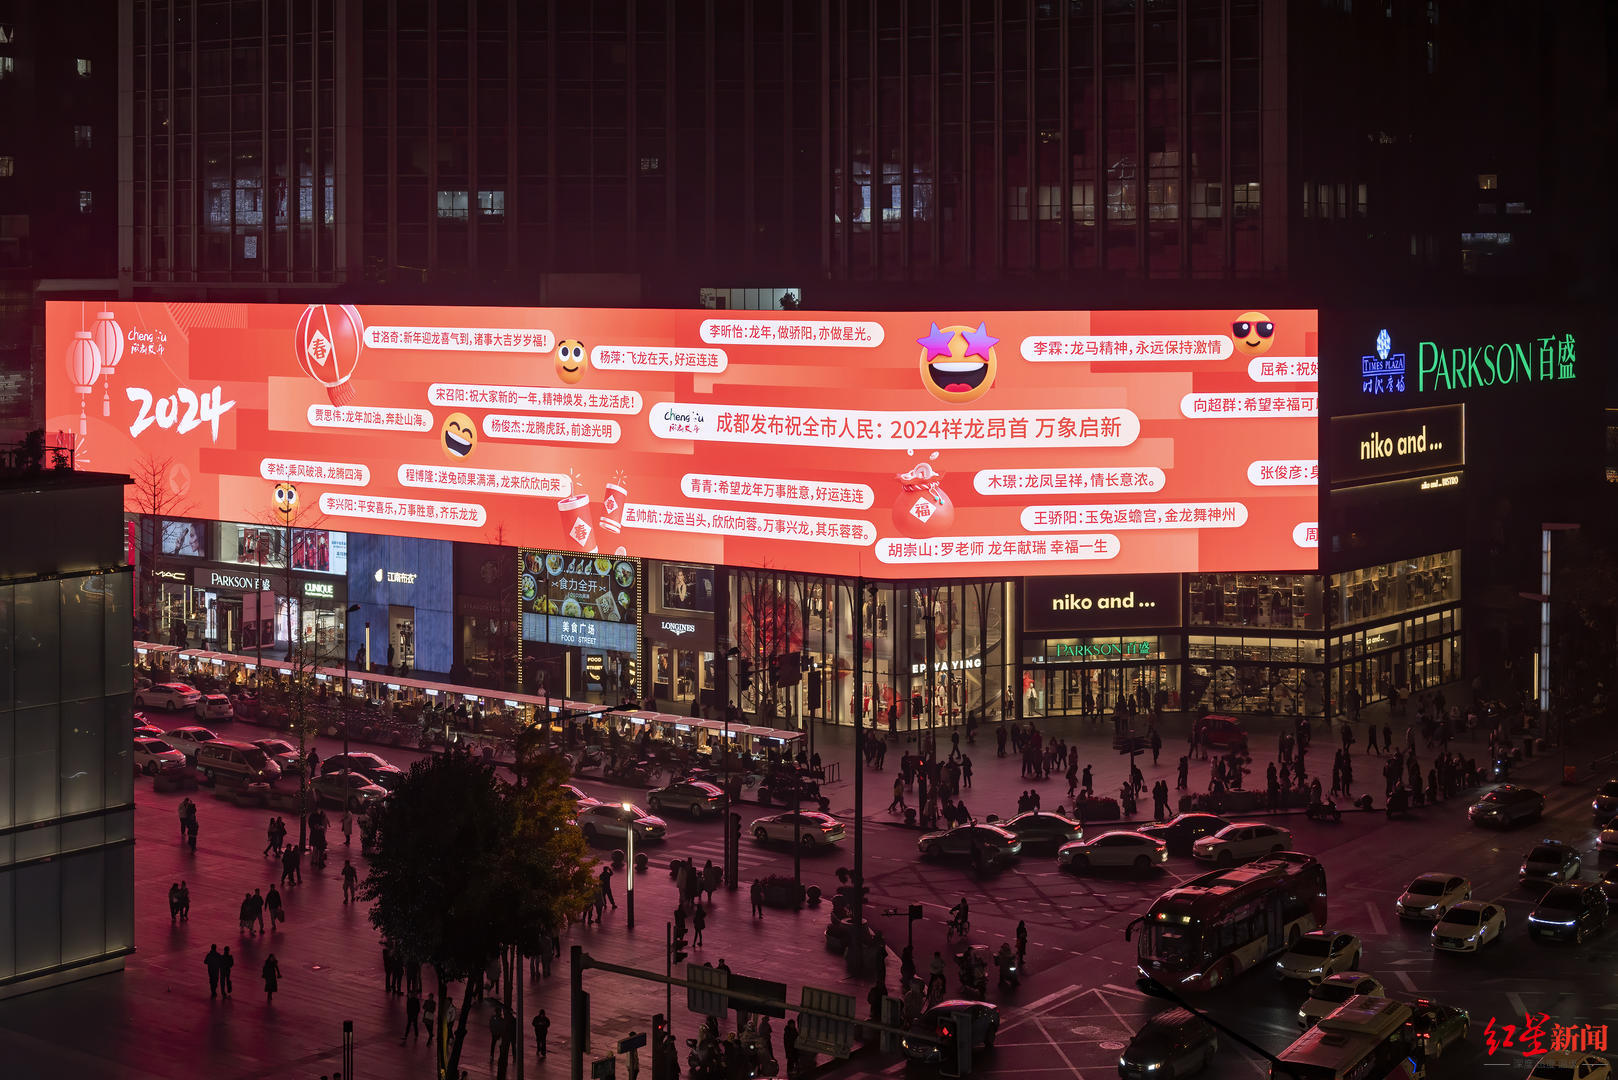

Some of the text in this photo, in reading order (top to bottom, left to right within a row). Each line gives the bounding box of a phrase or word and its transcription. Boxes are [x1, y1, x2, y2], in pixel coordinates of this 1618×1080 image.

[371, 329, 547, 348] 甘洛奇：新年迎龙喜气到，诸事大吉岁岁福！
[312, 338, 327, 361] 春
[1034, 340, 1222, 356] 李霖：龙马精神，永远保持激情
[599, 350, 719, 368] 杨萍：飞龙在天，好运连连
[1418, 333, 1577, 393] PARKSON 百盛
[436, 388, 635, 409] 宋召阳：祝大家新的一年，精神焕发，生龙活虎！
[1194, 396, 1318, 412] 向超群：希望幸福可
[125, 385, 236, 443] 2024
[316, 407, 427, 428] 贾思伟：龙年加油，奔赴山海。
[491, 419, 613, 439] 杨俊杰：龙腾虎跃，前途光明
[1035, 416, 1121, 439] 万象启新
[1360, 432, 1393, 460] niko
[1397, 425, 1427, 455] and
[268, 463, 363, 481] 李祯：乘风破浪，龙腾四海
[691, 479, 864, 504] 青青：希望龙年万事胜意，好运连连
[327, 498, 478, 522] 李兴阳：平安喜乐，万事胜意，齐乐龙龙
[914, 502, 931, 517] 福
[1034, 507, 1236, 526] 王骄阳：玉兔返蟾宫，金龙舞神州
[988, 540, 1046, 556] 龙年献瑞
[1051, 539, 1108, 555] 幸福一生
[211, 572, 253, 589] PARKSON
[304, 583, 334, 594] CLINIQUE
[559, 577, 598, 593] 食力全开
[1052, 595, 1092, 612] niko
[1097, 591, 1135, 610] and
[562, 621, 595, 636] 美食广场
[661, 621, 696, 633] LONGINES
[561, 634, 597, 645] FOOD STREET
[1056, 642, 1122, 657] PARKSON
